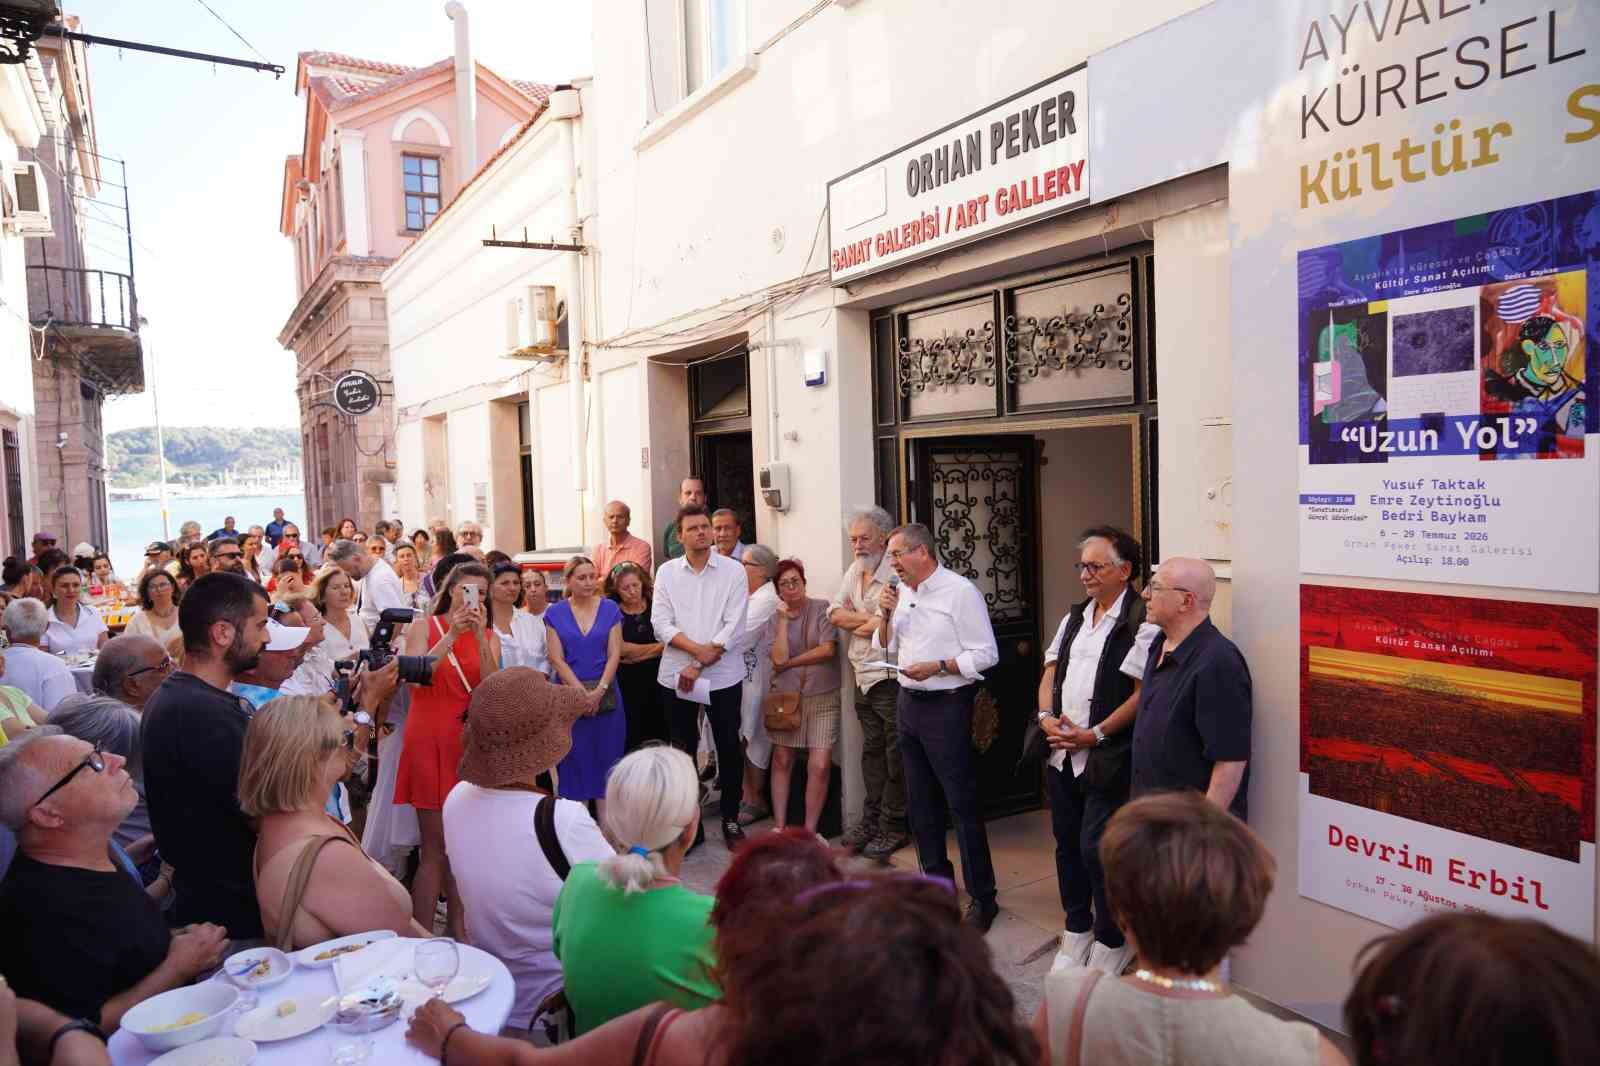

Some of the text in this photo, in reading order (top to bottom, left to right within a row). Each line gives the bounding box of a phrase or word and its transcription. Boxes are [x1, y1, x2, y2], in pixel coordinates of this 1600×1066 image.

[1302, 11, 1586, 139] KÜRESEL
[907, 90, 1077, 197] ORHAN PEKER
[1300, 118, 1513, 208] Kültür
[832, 159, 1085, 272] SANAT GALERİSİ / ART GALLERY
[1375, 277, 1408, 291] Kültür
[1414, 270, 1447, 284] Sanat
[1382, 479, 1486, 490] Yusuf Taktak
[1370, 494, 1501, 510] Emre Zeytinoğlu
[1382, 510, 1424, 521] Bedri
[1431, 511, 1487, 525] Baykam
[1422, 530, 1457, 540] Temmuz
[1375, 635, 1493, 657] Kültür Sanat Açılımı
[1328, 824, 1548, 910] Devrim Erbil
